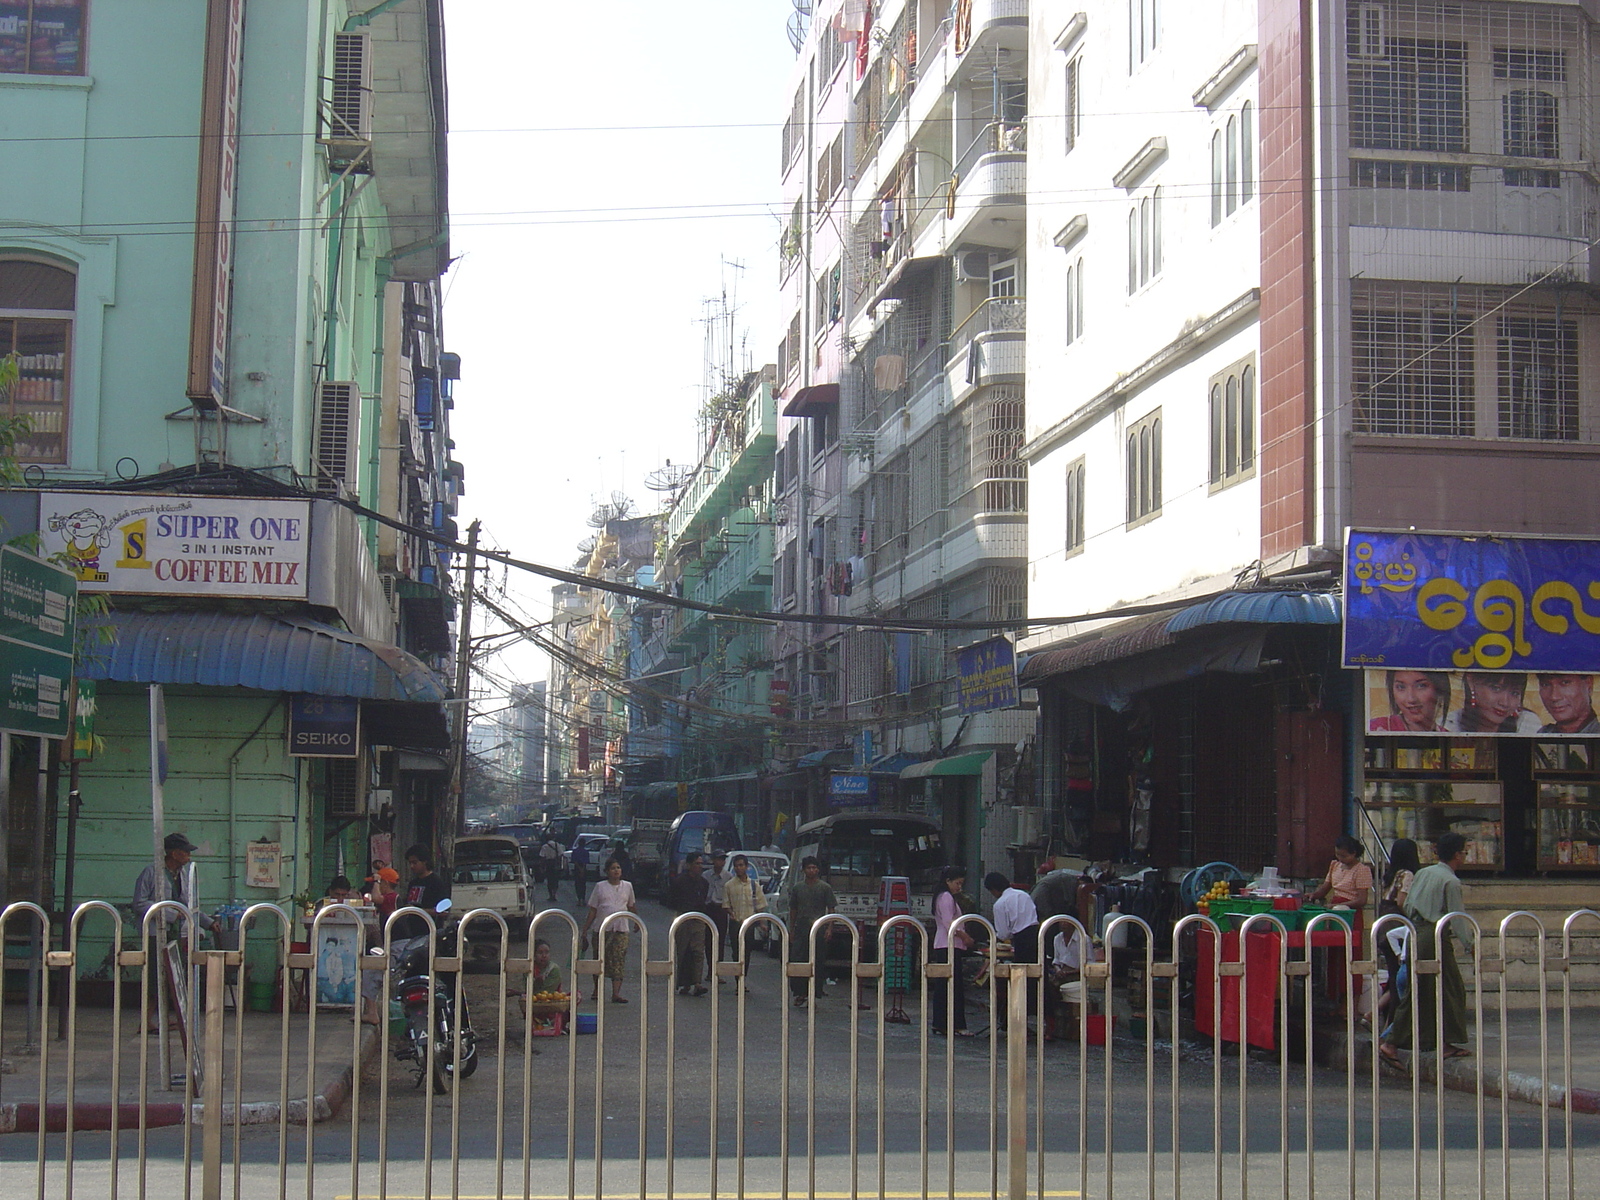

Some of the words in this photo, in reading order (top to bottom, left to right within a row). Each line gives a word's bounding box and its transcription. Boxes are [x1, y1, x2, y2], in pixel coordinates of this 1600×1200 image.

[156, 514, 241, 540] SUPER
[250, 516, 300, 542] ONE
[181, 544, 190, 553] 3
[195, 544, 207, 554] IN
[212, 545, 217, 554] 1
[222, 545, 275, 556] INSTANT
[154, 558, 248, 584] COFFEE
[251, 561, 300, 586] MIX
[296, 732, 351, 745] SEIKO
